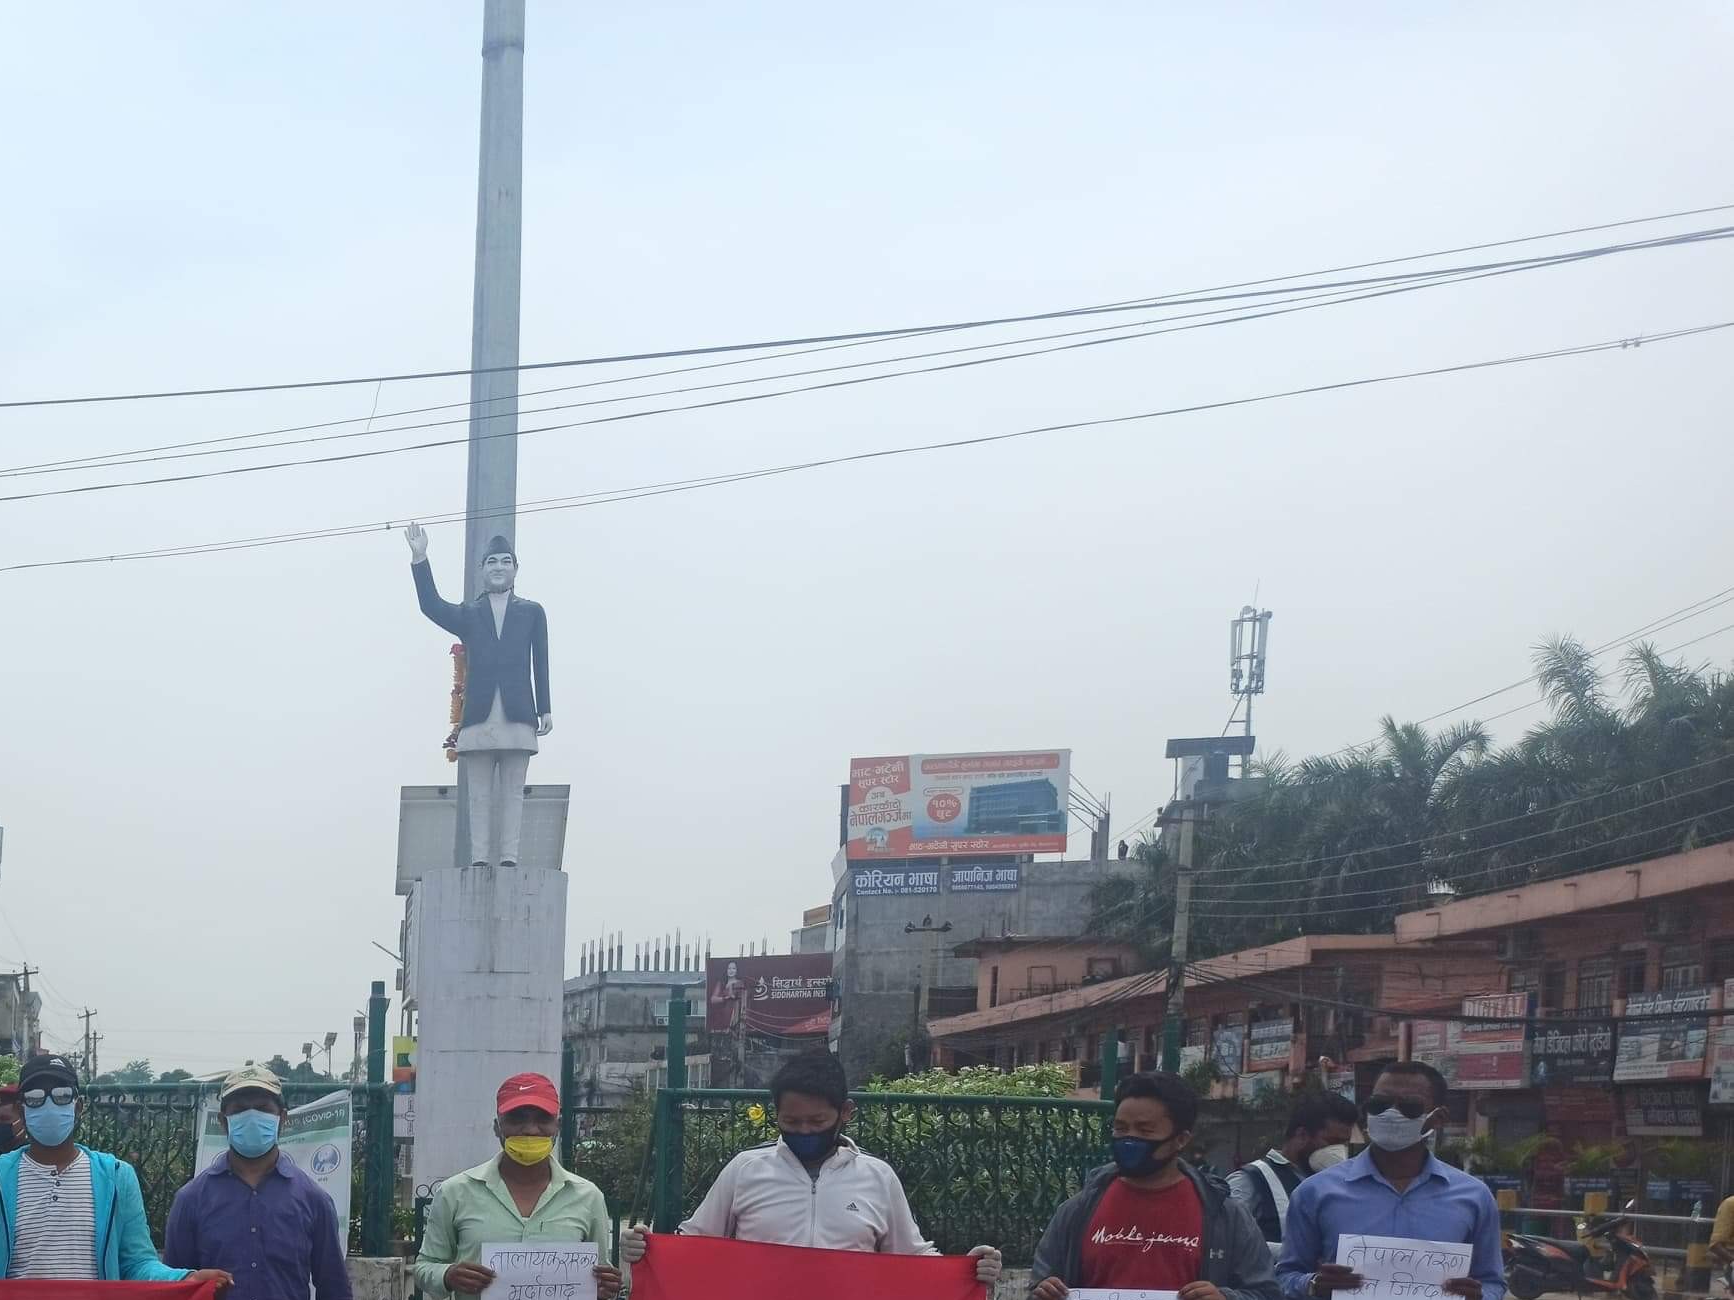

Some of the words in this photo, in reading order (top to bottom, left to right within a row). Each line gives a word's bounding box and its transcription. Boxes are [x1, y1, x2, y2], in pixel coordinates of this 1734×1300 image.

[855, 869, 905, 888] कोरियन
[908, 872, 939, 887] भाषा
[952, 866, 993, 883] जापानिज
[995, 869, 1018, 882] भाषा
[856, 888, 881, 896] Contact
[770, 989, 812, 1000] SIDDHARTHA
[1145, 1230, 1201, 1253] jeans
